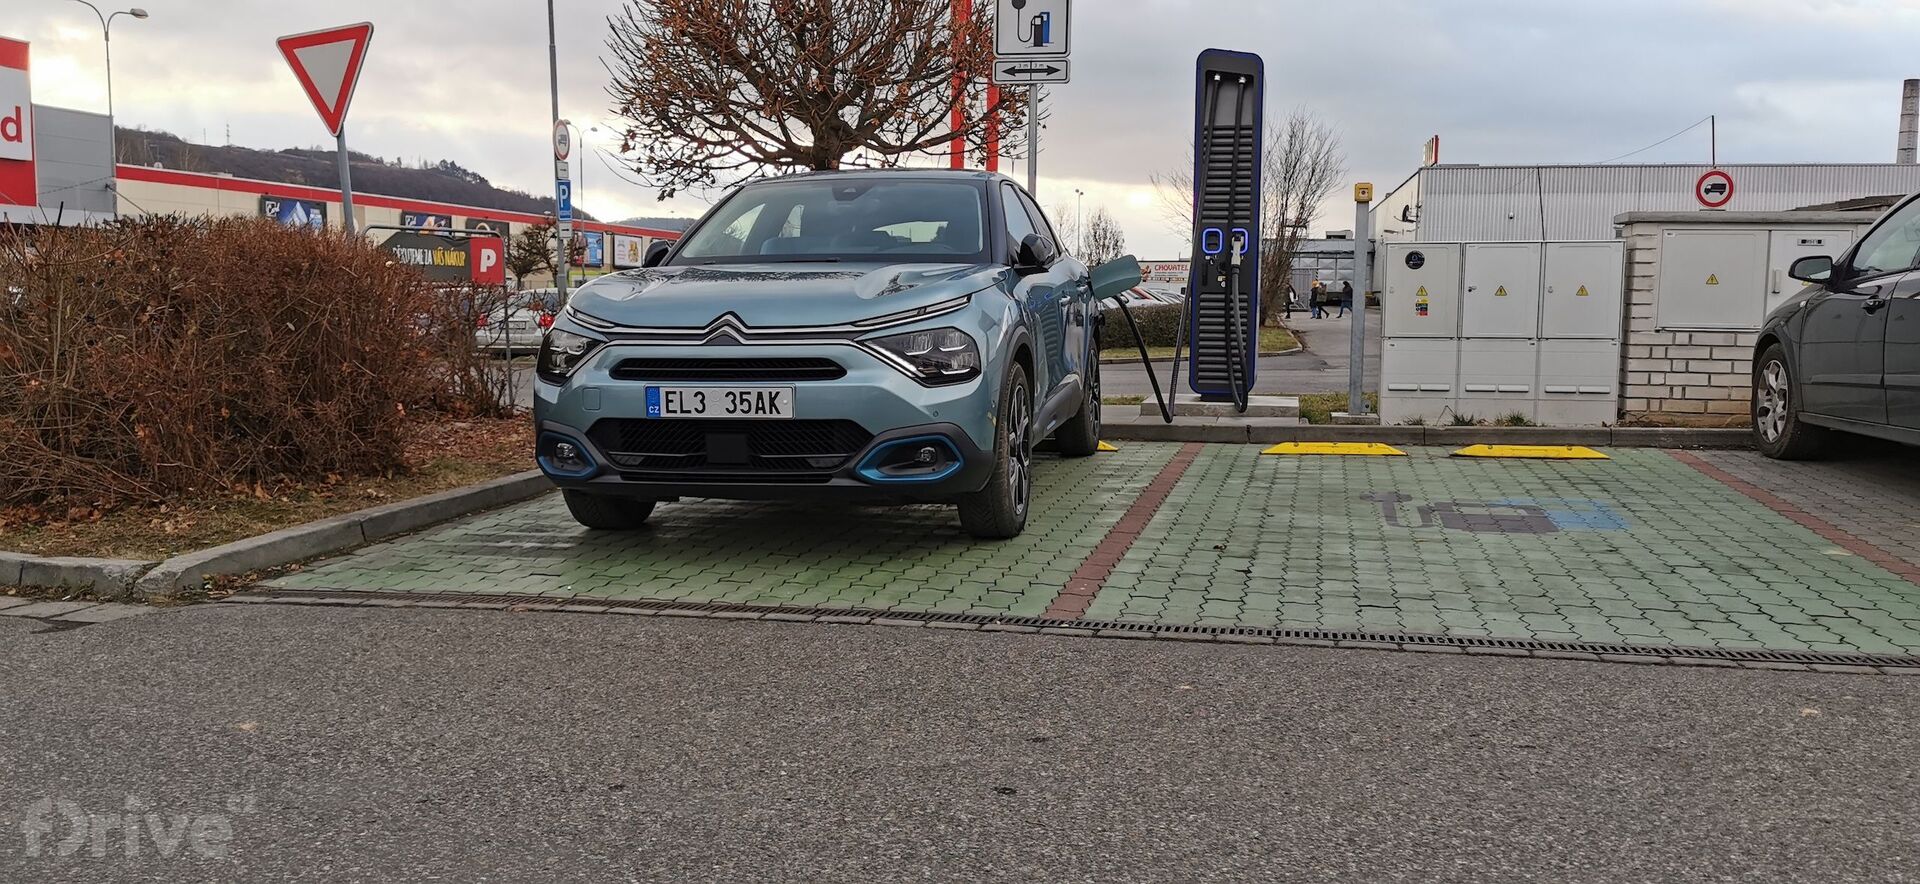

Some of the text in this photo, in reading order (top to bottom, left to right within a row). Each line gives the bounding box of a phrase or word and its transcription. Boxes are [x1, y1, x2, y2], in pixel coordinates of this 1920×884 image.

[559, 184, 569, 208] P
[424, 249, 433, 265] ZA
[433, 246, 444, 266] VÁŠ
[444, 247, 465, 267] NÁKUP
[480, 248, 497, 272] P
[648, 406, 660, 414] CZ
[665, 391, 781, 415] EL3 35AK
